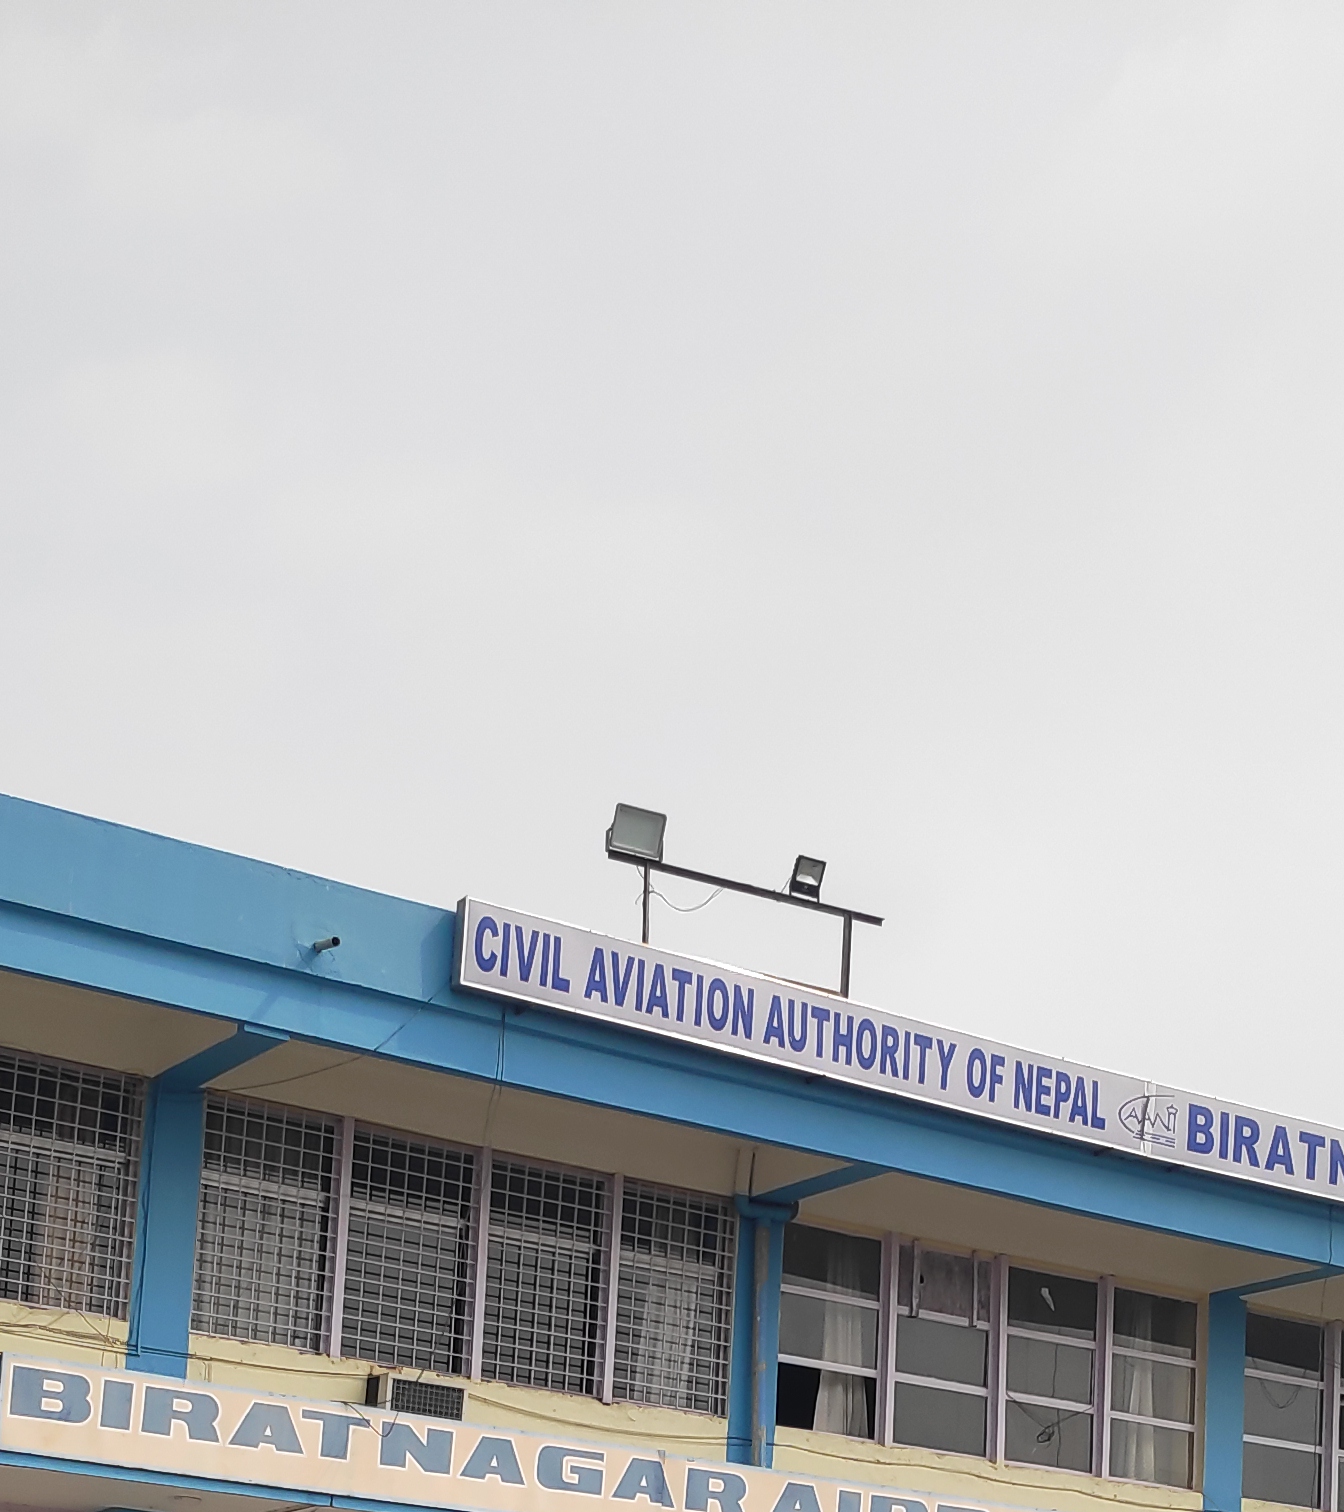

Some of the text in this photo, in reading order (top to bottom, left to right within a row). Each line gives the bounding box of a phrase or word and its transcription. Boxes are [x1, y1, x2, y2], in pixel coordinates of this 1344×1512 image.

[474, 916, 570, 993] CIVIL
[584, 948, 754, 1040] AVIATION
[762, 994, 956, 1091] AUTHORITY
[967, 1048, 1006, 1103] OF
[1014, 1062, 1106, 1129] NEPAL
